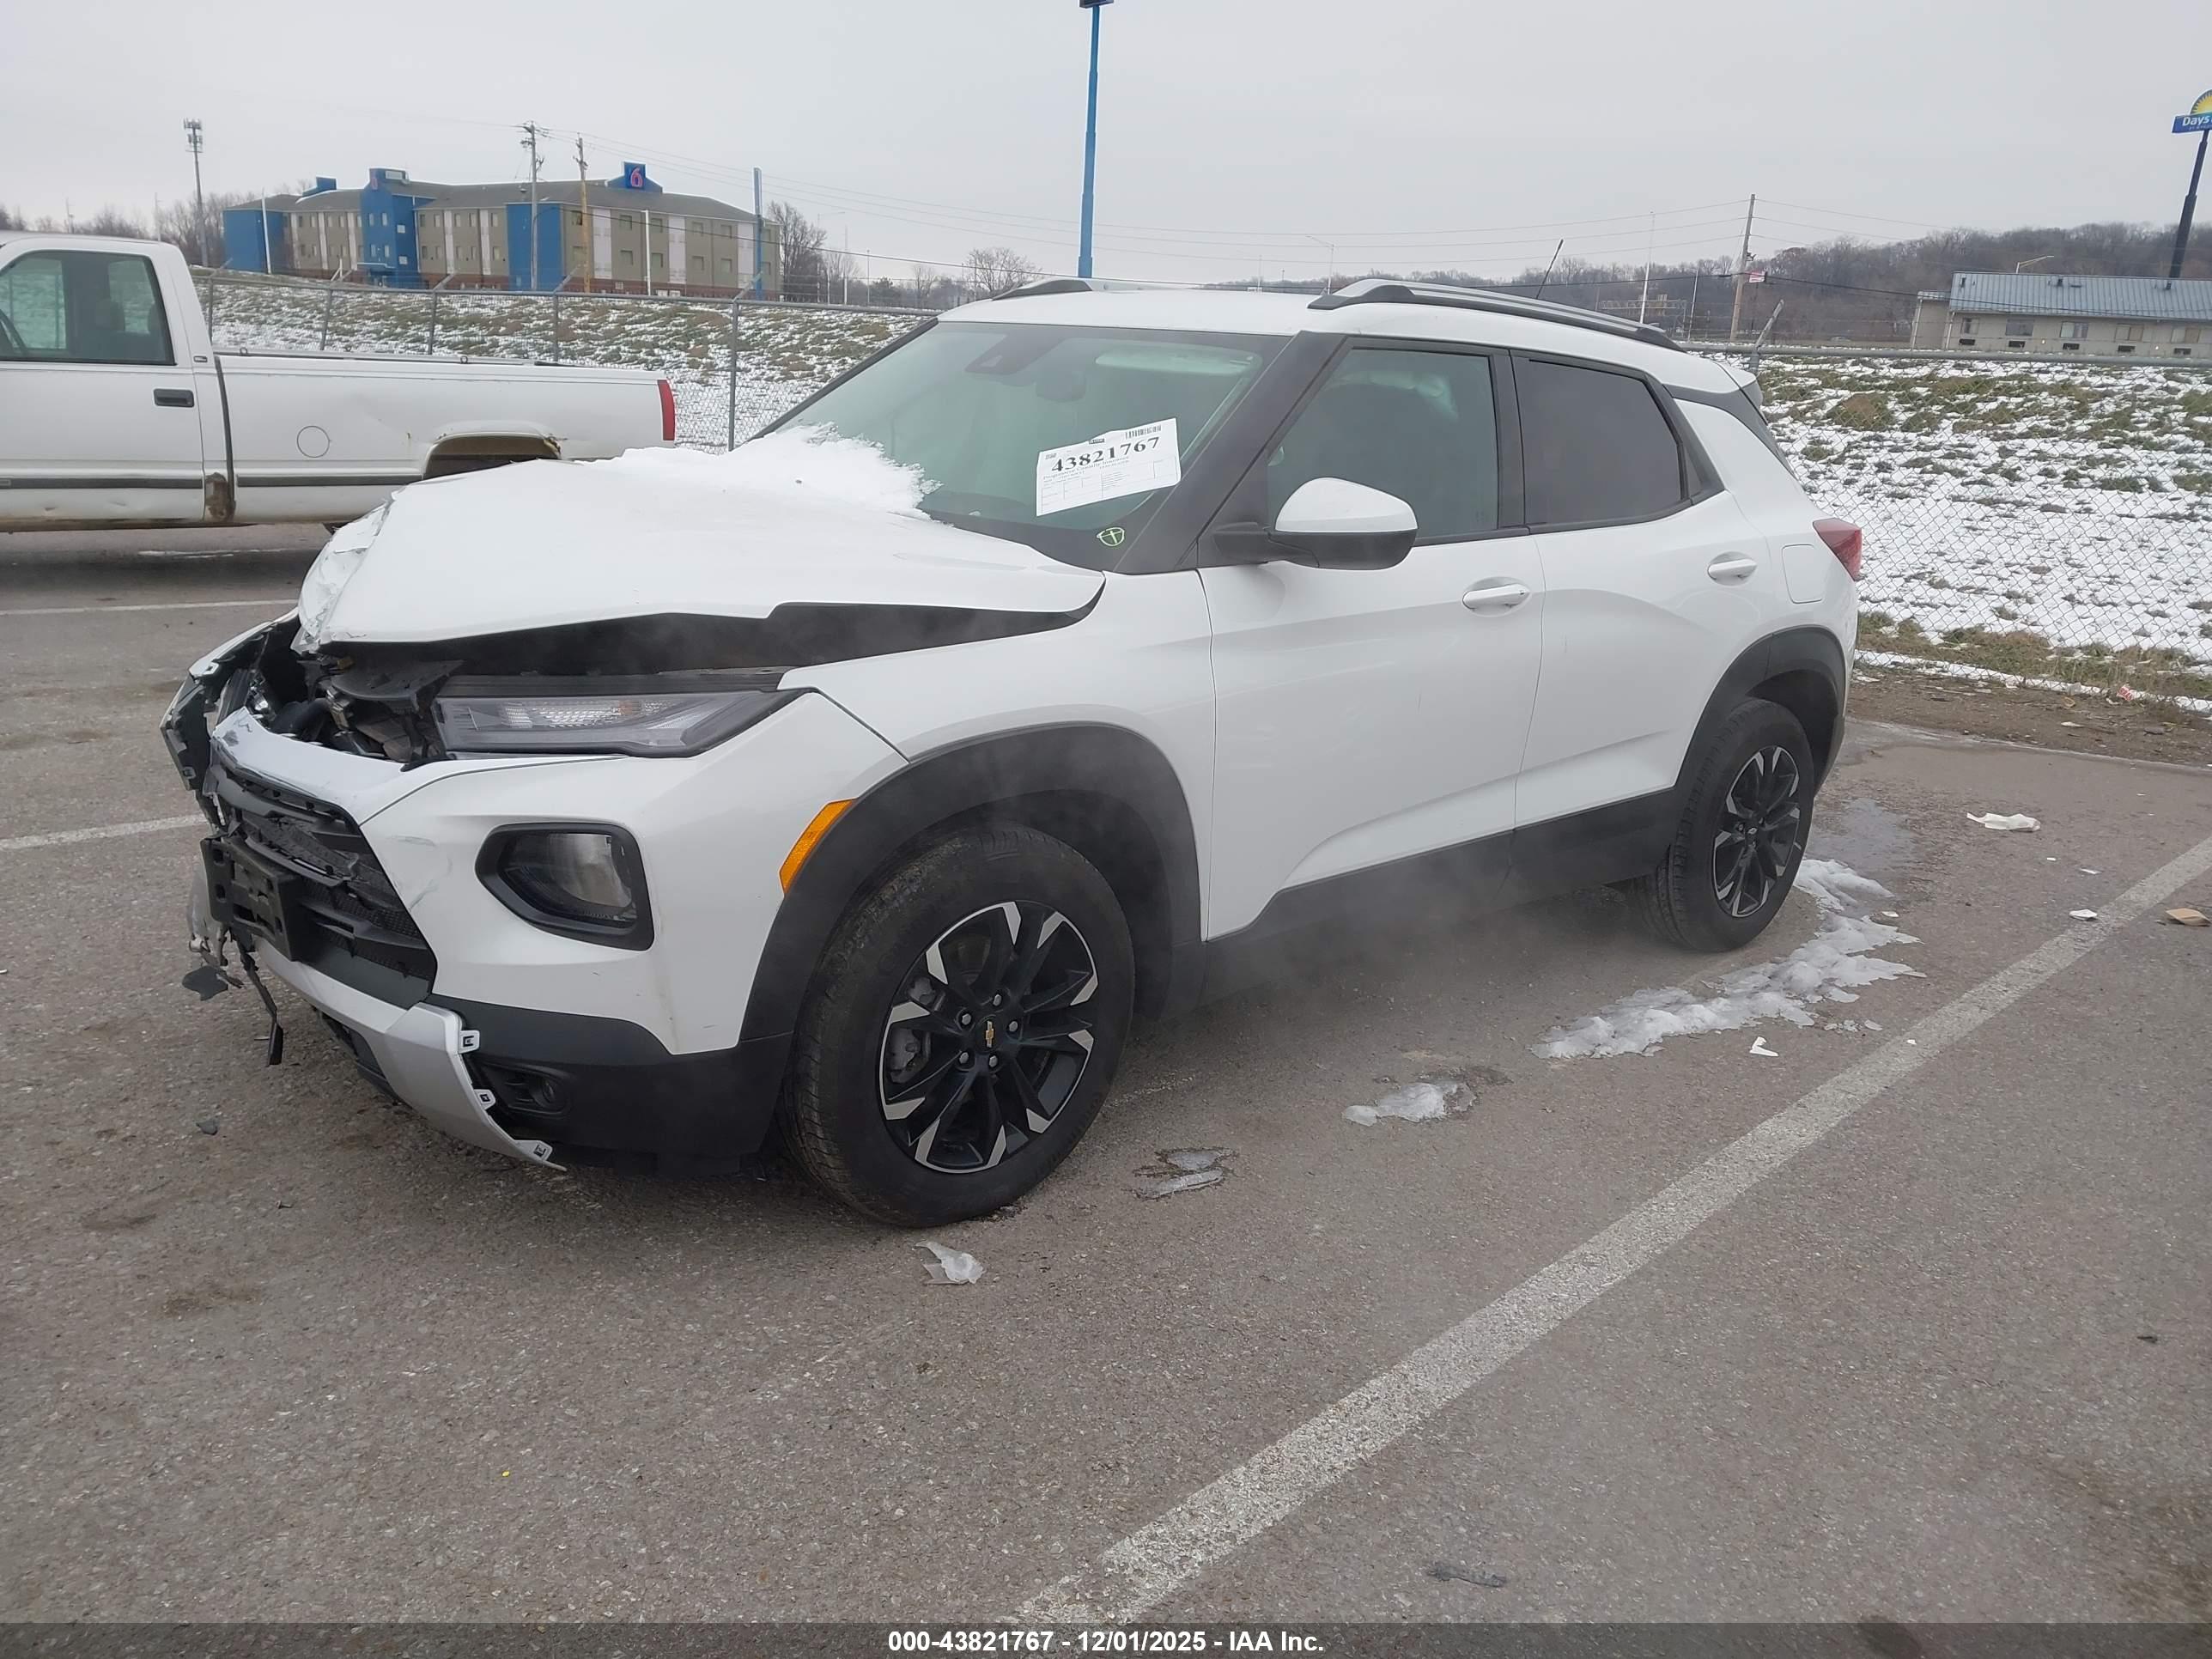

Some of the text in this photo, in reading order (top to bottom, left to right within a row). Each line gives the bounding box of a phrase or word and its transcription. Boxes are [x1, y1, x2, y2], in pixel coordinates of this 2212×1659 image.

[2182, 116, 2210, 126] Days
[630, 167, 643, 187] 6
[1051, 437, 1159, 471] 43821767
